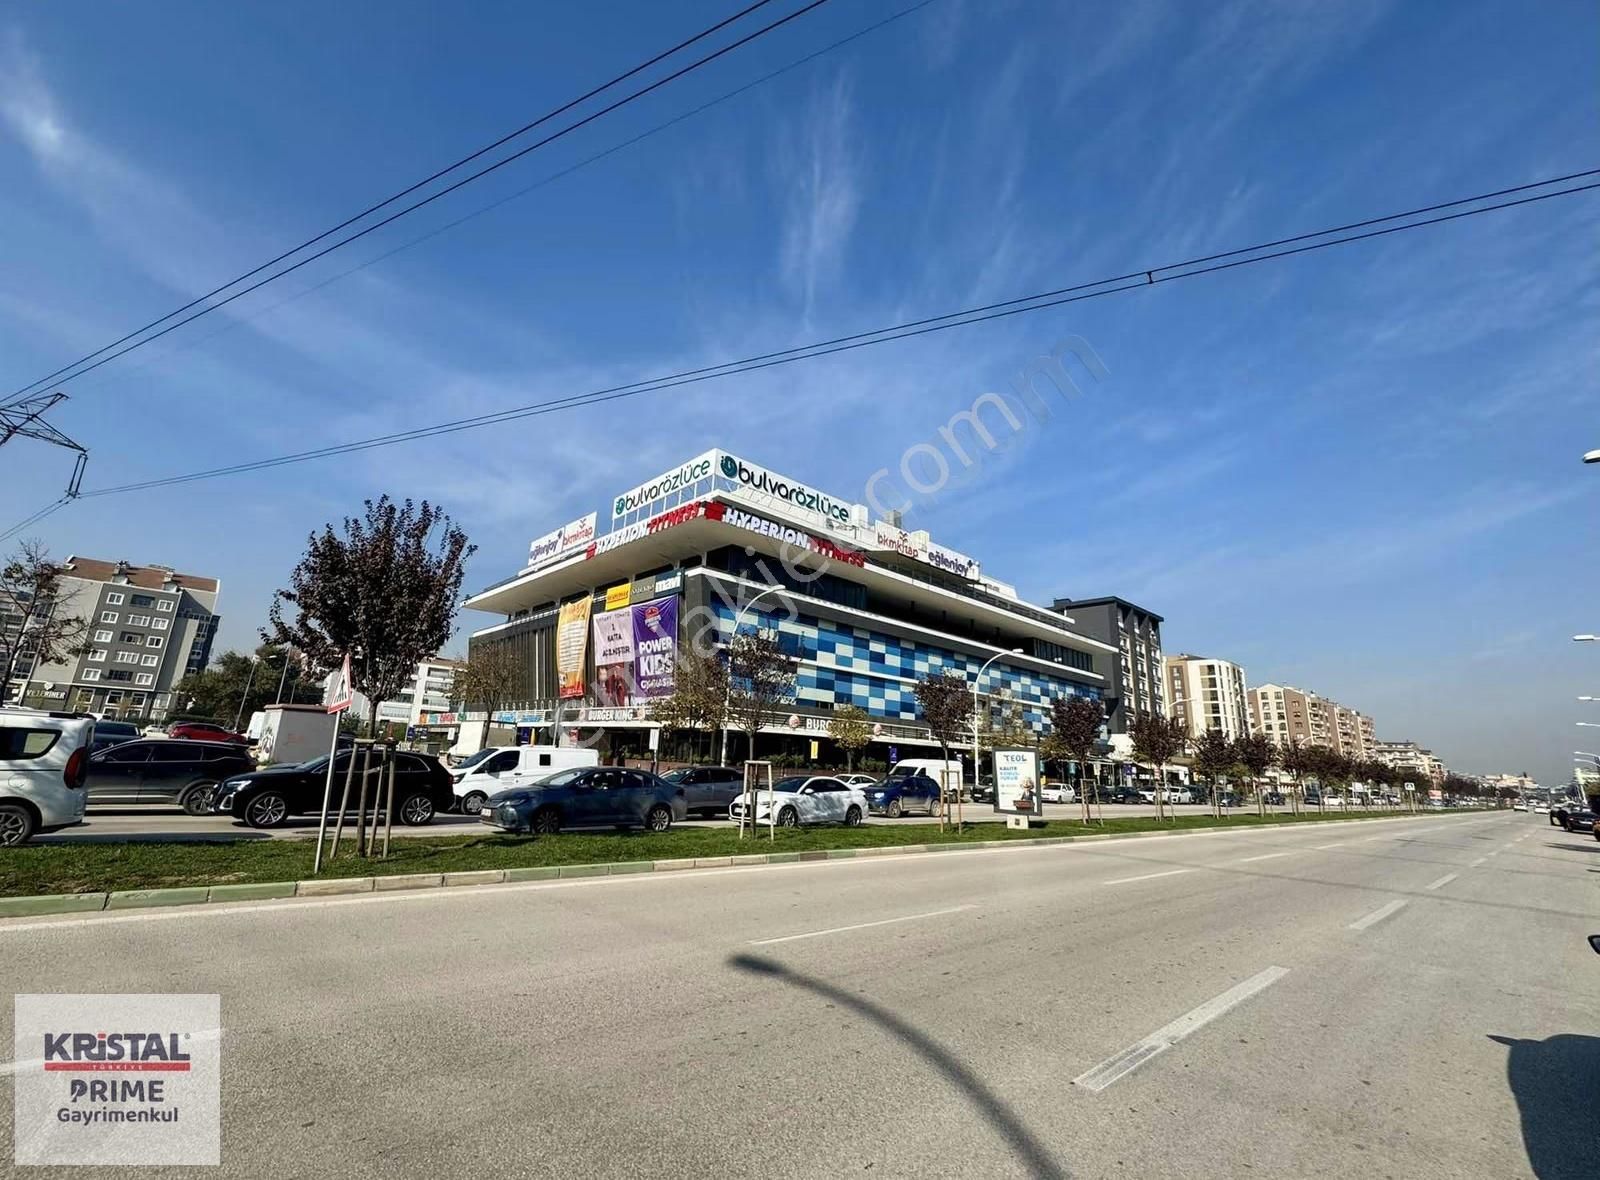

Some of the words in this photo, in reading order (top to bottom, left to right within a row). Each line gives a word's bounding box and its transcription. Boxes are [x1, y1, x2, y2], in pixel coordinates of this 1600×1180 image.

[625, 460, 710, 511] bulvarözlüce
[738, 461, 850, 522] bulvarözlüce
[595, 520, 648, 556] HYPERION
[723, 506, 809, 549] HYPERION
[639, 636, 673, 655] POWER
[640, 652, 675, 677] KIDS
[588, 709, 614, 720] BURGER
[614, 708, 633, 720] KING
